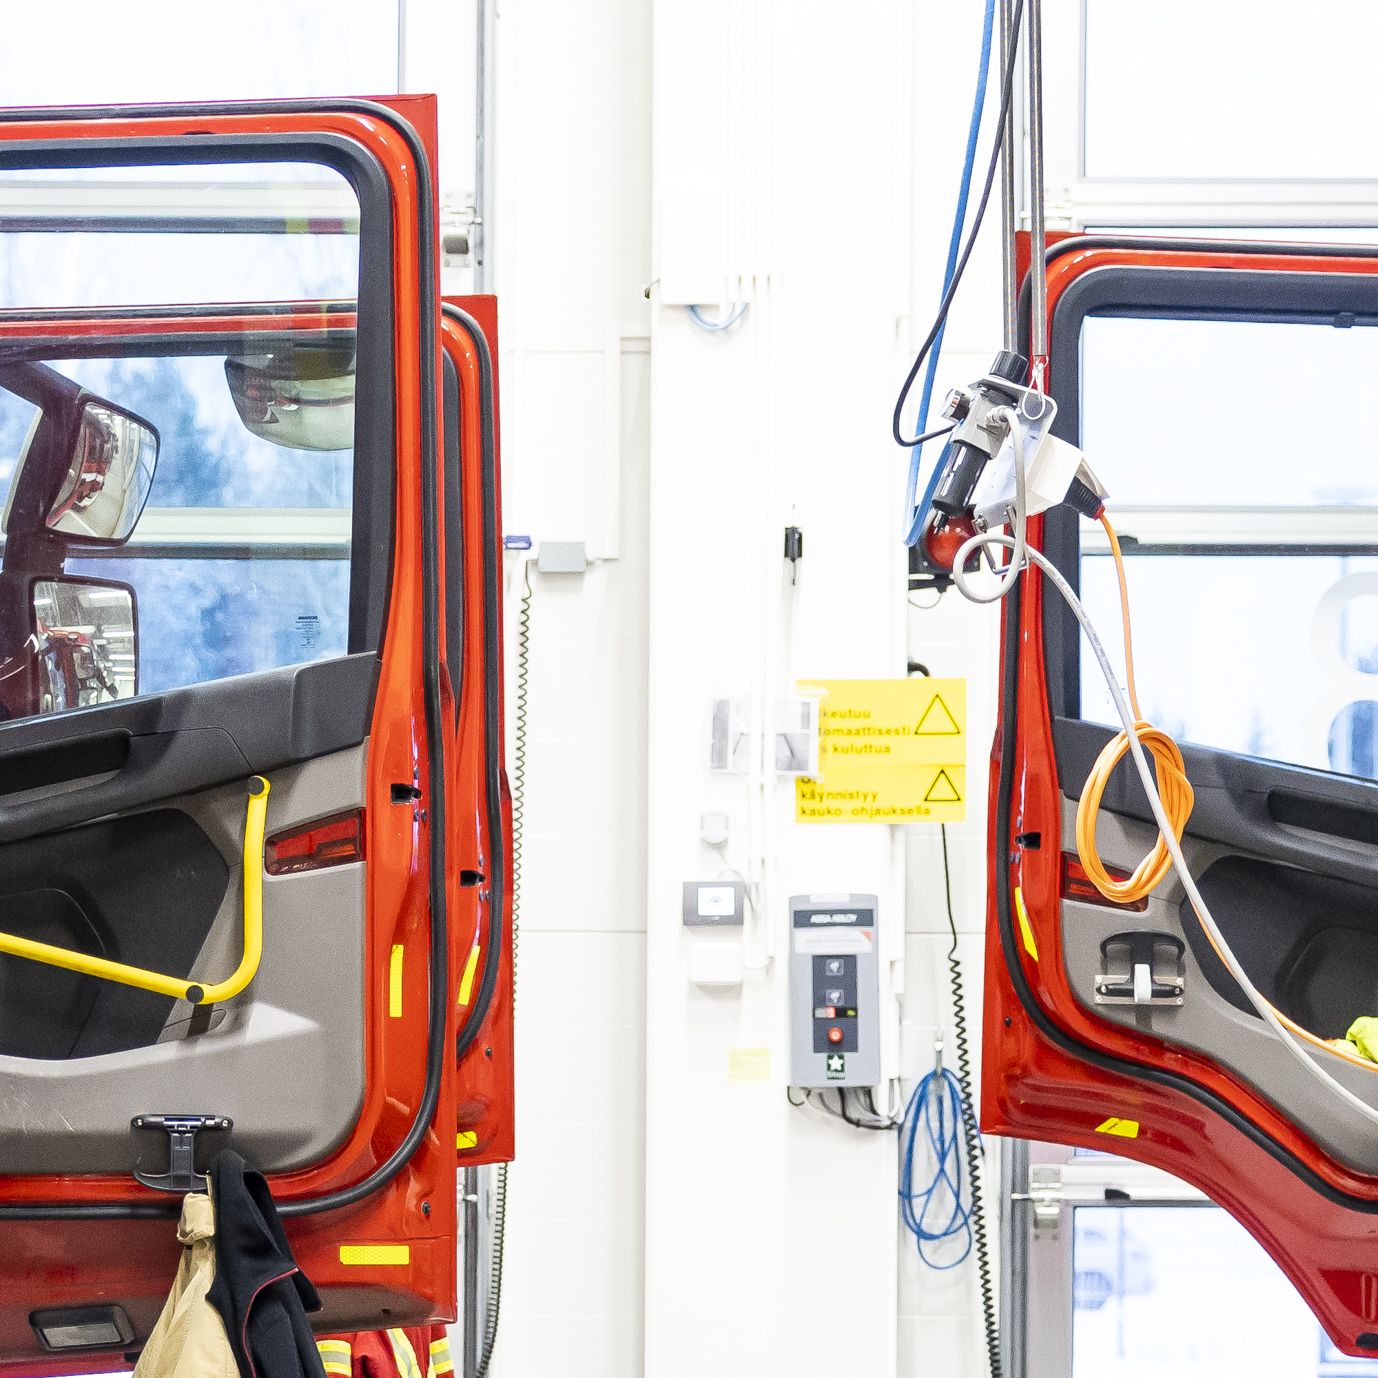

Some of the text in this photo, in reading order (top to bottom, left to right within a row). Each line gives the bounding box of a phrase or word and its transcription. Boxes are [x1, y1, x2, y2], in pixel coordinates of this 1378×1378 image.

[833, 744, 891, 754] kuluttua
[800, 790, 878, 802] käynnistyy
[800, 806, 931, 818] kauko-ohjauksella
